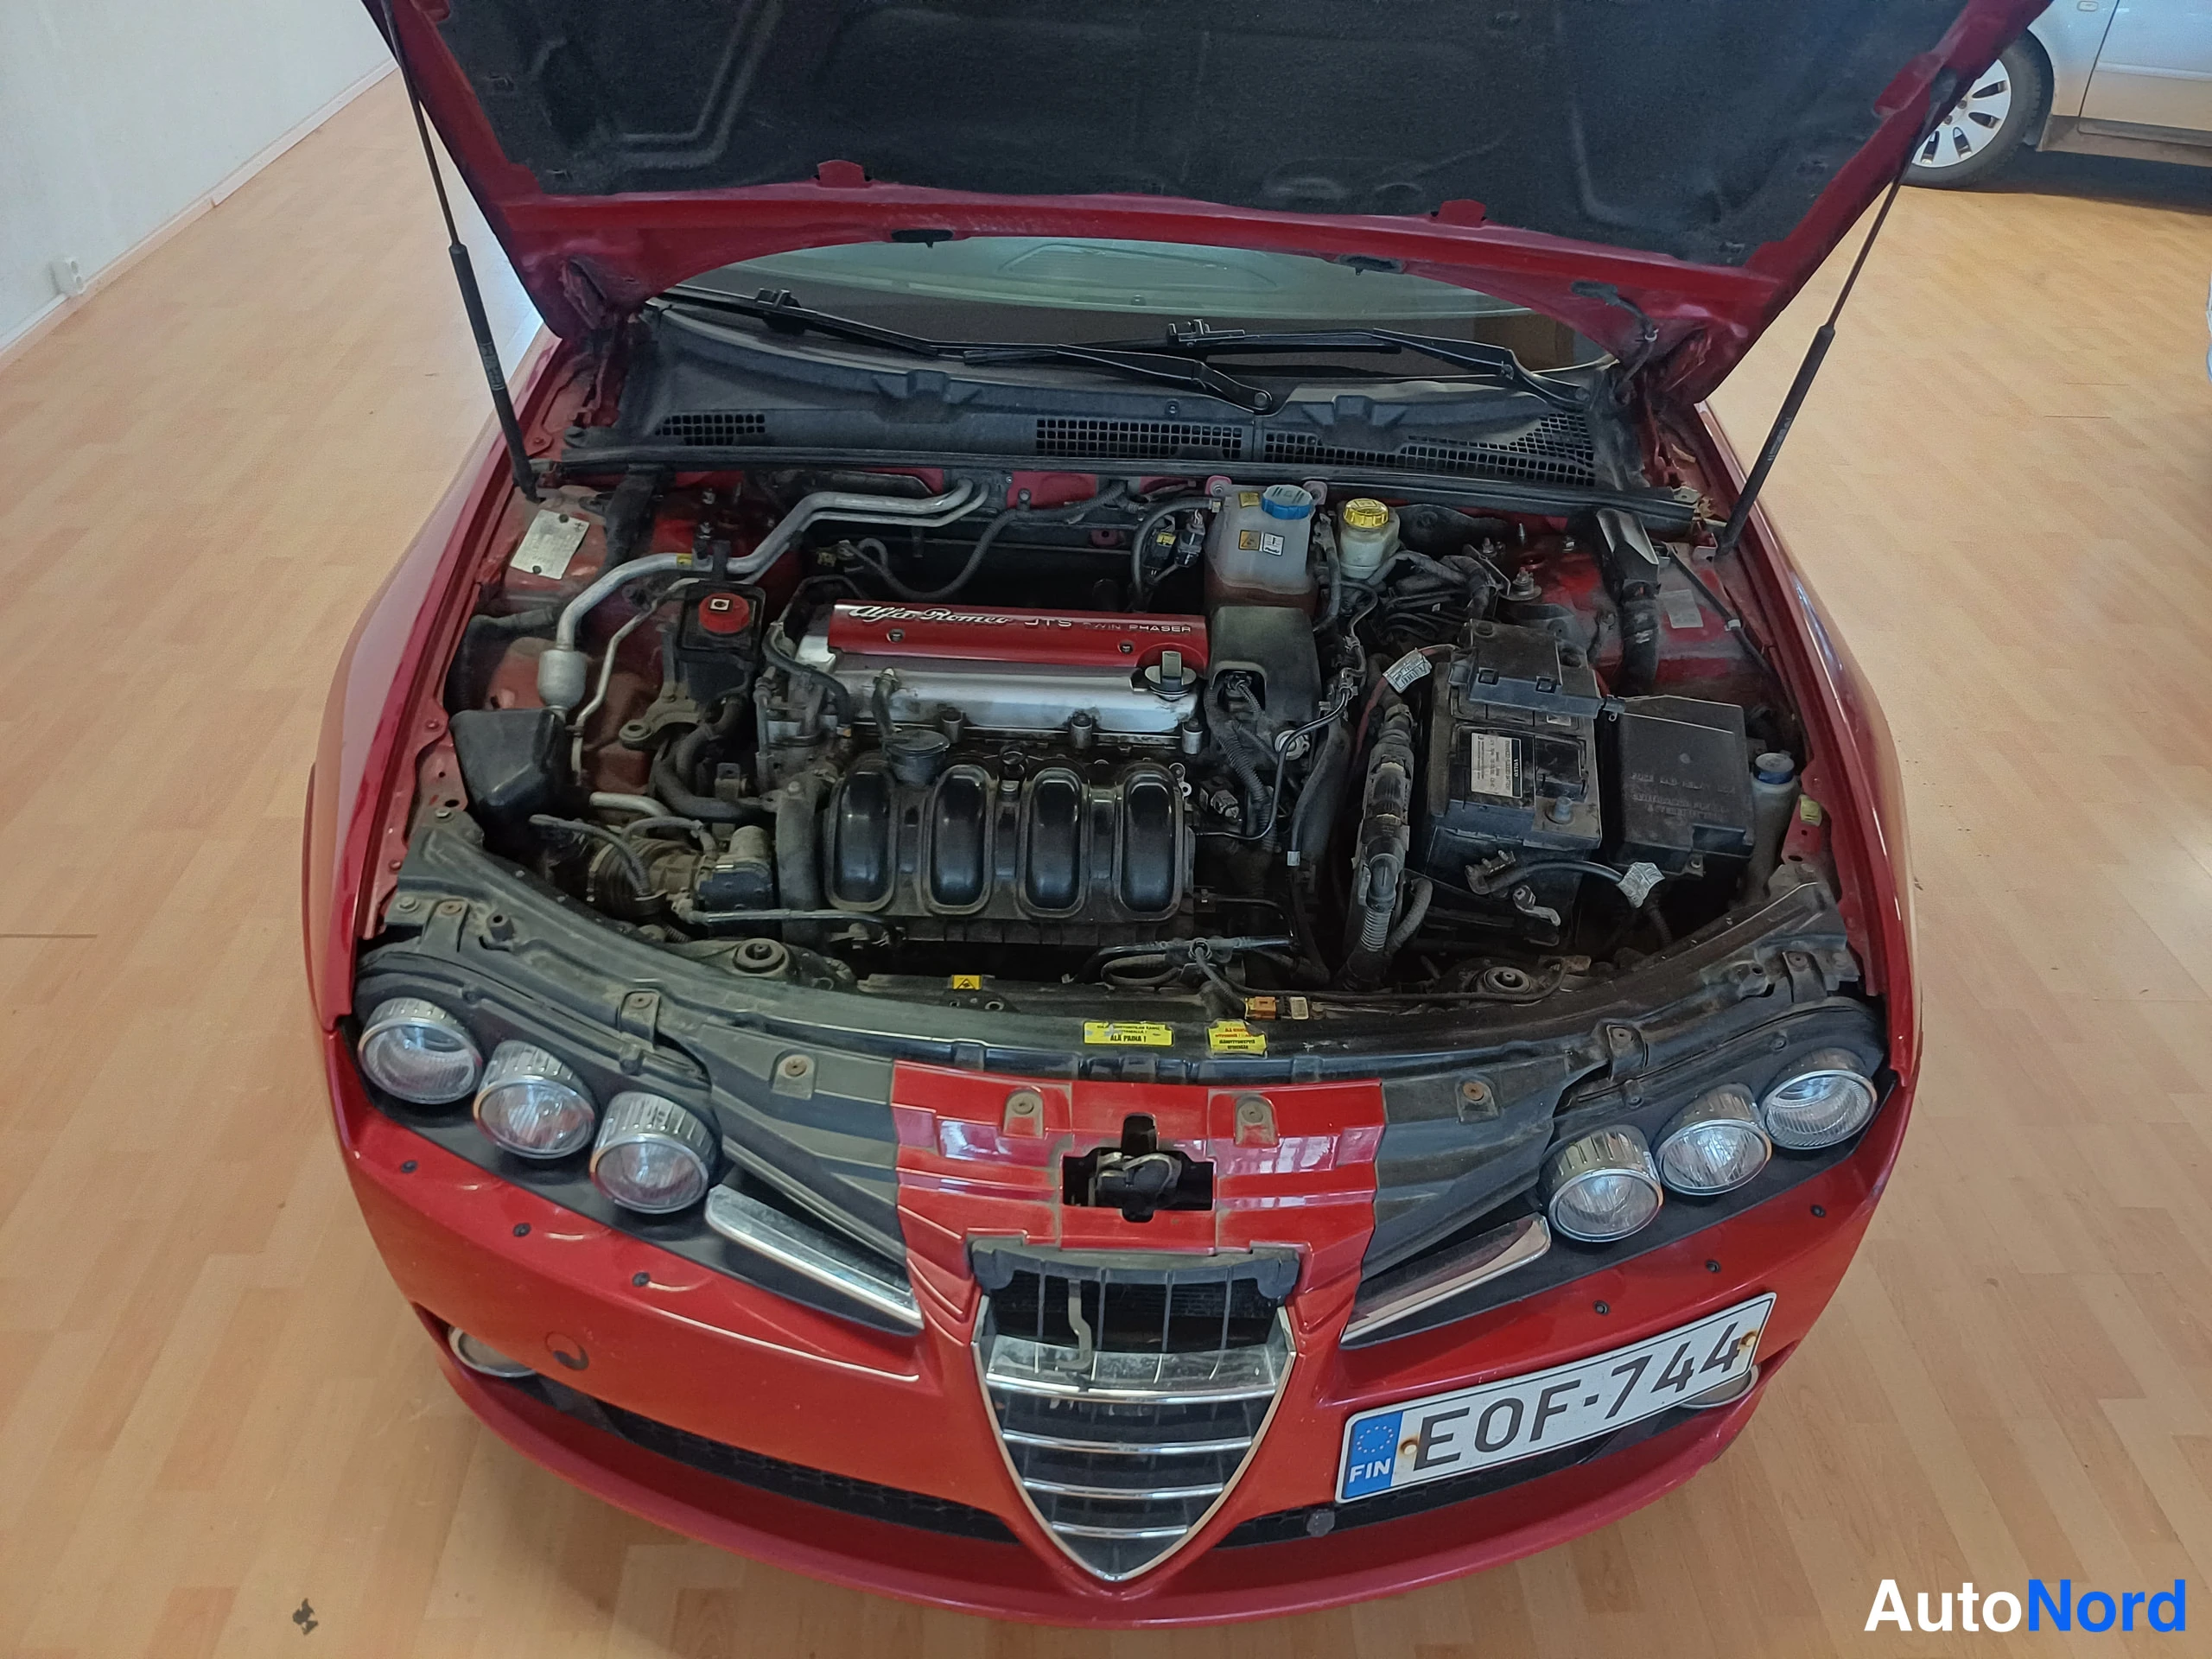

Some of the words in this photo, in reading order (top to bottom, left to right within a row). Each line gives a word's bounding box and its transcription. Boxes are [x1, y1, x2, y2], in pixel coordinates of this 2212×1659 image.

[849, 606, 916, 623] Alfa
[920, 607, 1012, 625] Romeo
[1025, 618, 1072, 627] JTS
[1128, 624, 1192, 632] PHASER
[1413, 1321, 1741, 1471] EOF-744
[1349, 1457, 1391, 1484] FIN
